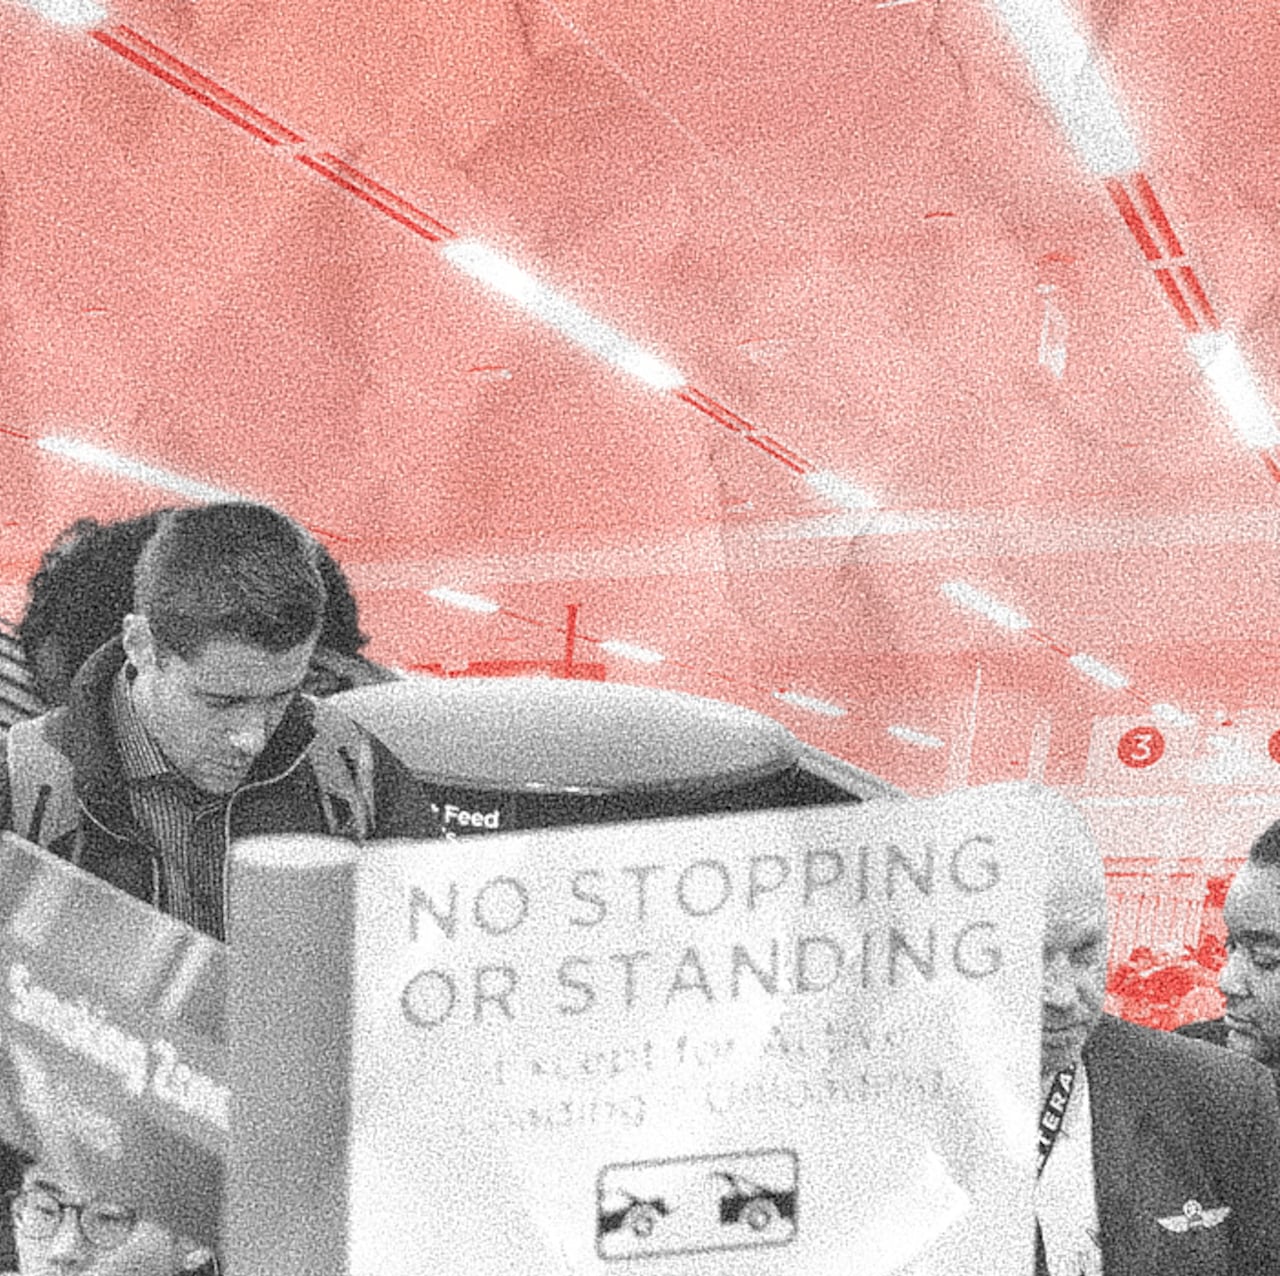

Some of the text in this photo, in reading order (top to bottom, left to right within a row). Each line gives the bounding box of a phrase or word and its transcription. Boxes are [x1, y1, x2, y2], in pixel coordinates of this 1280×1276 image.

[1131, 733, 1153, 760] 3
[444, 804, 500, 829] Feed
[408, 834, 1002, 942] NO STOPPING
[399, 920, 1004, 1030] OR STANDING
